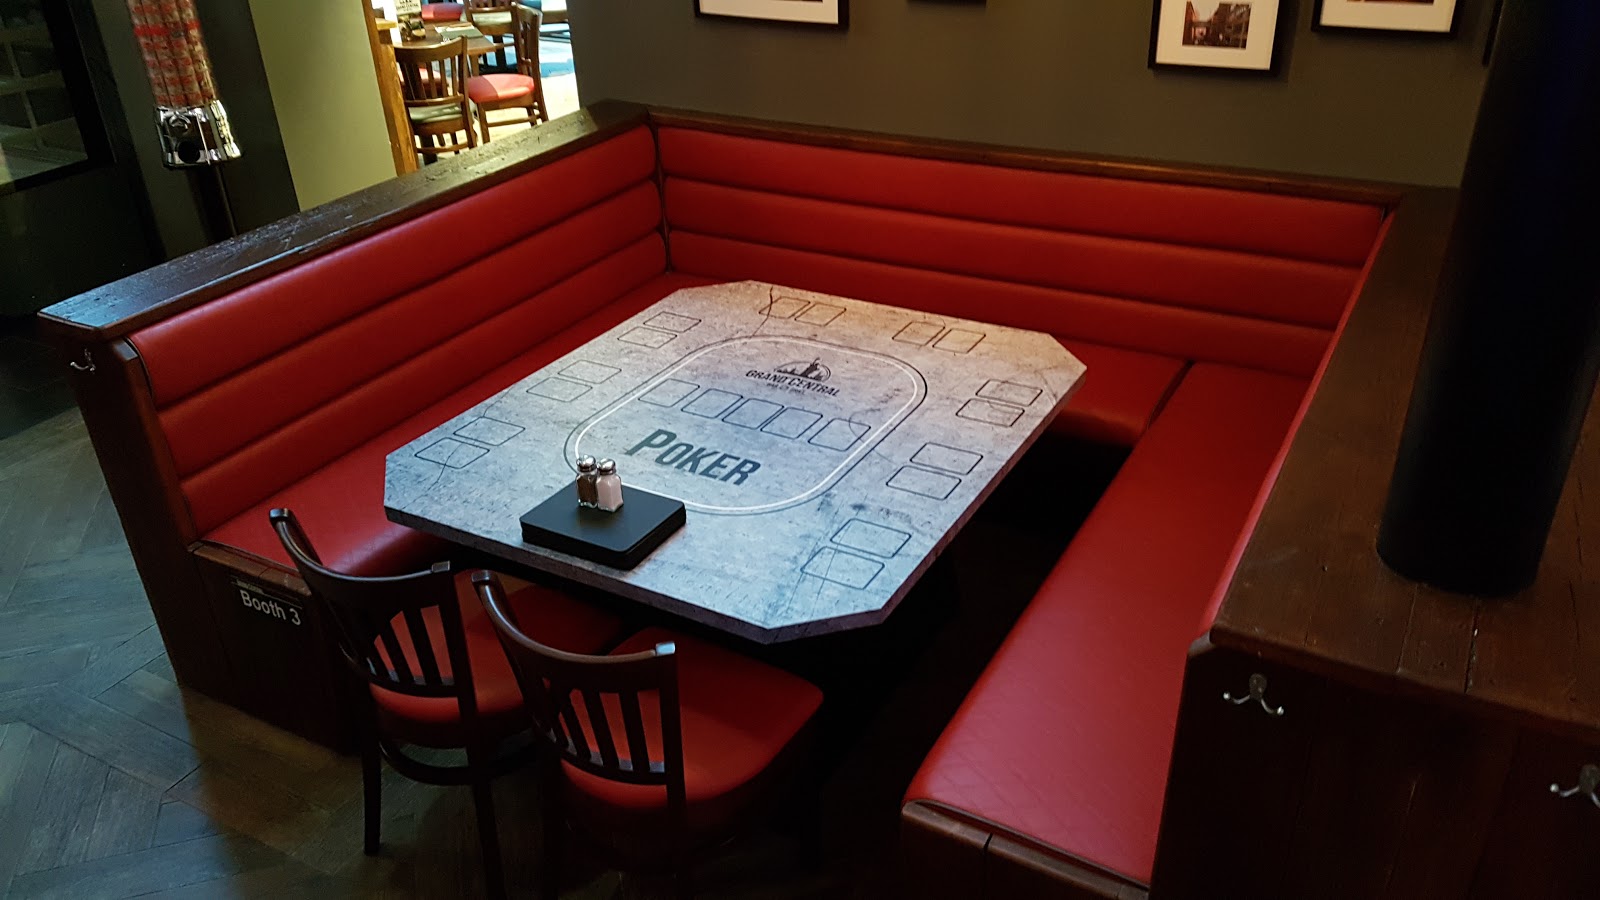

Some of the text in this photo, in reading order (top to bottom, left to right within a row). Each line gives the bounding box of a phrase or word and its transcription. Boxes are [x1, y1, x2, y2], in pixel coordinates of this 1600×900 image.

[745, 369, 788, 384] GRAND
[788, 377, 840, 396] CENTRAL
[625, 428, 761, 486] POKER
[240, 589, 302, 626] Booth 3
